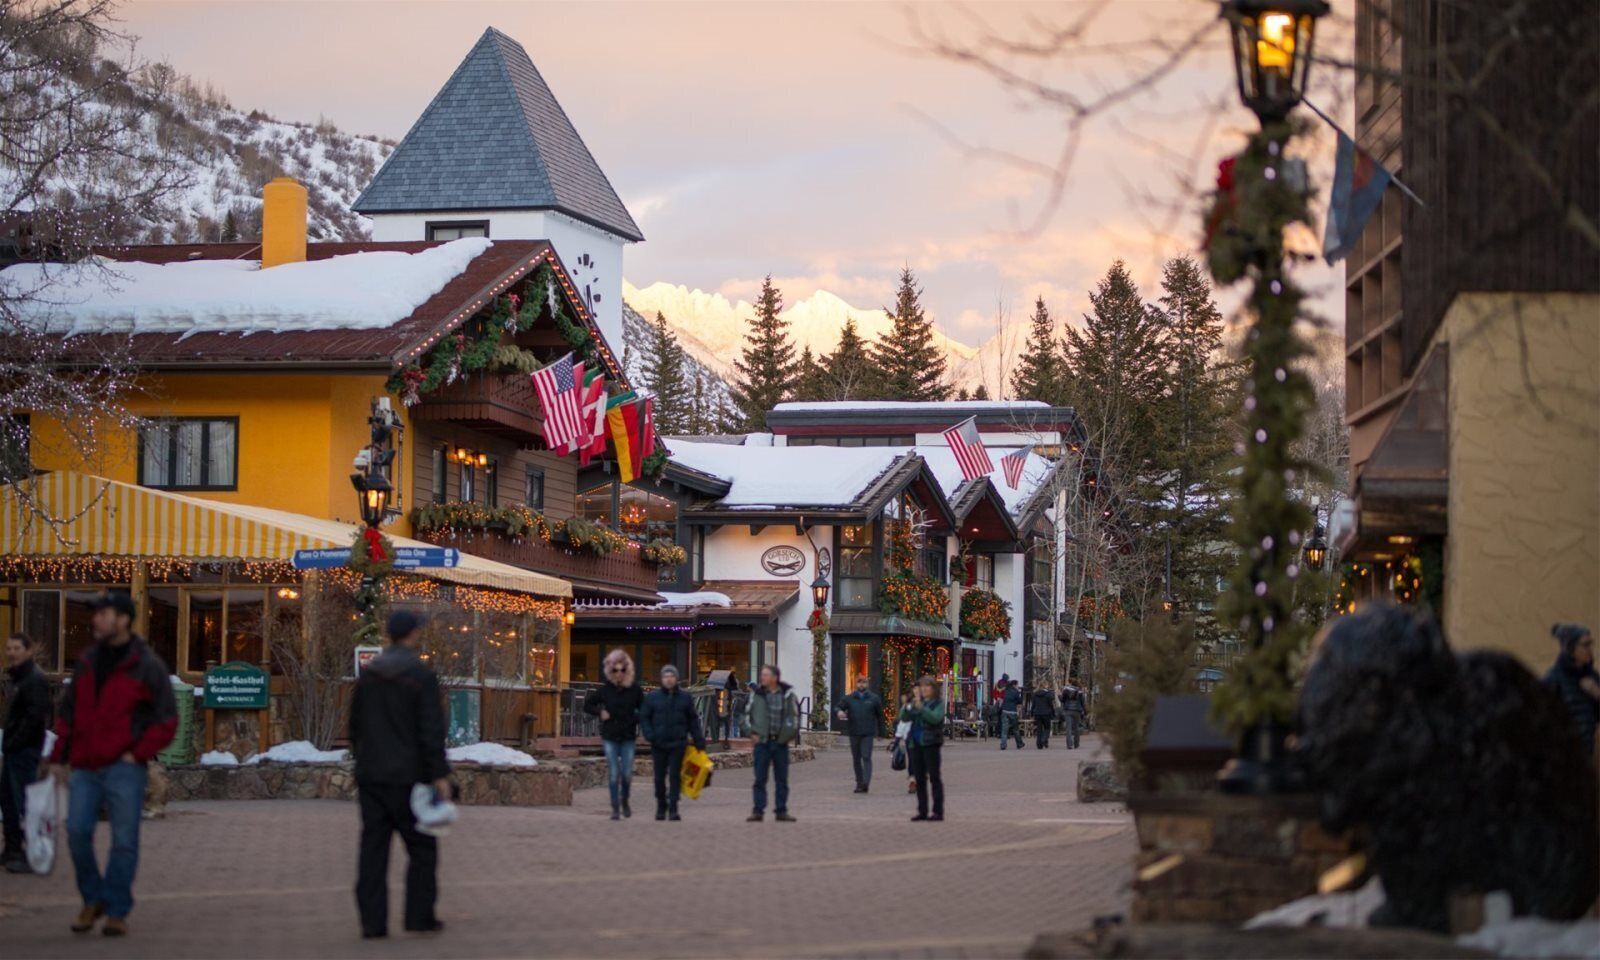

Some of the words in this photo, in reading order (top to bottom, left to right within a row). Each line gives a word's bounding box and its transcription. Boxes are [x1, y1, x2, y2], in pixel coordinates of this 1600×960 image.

[413, 549, 427, 557] One
[767, 549, 800, 560] GORSUCH
[207, 675, 265, 685] Hotel-Gasthof
